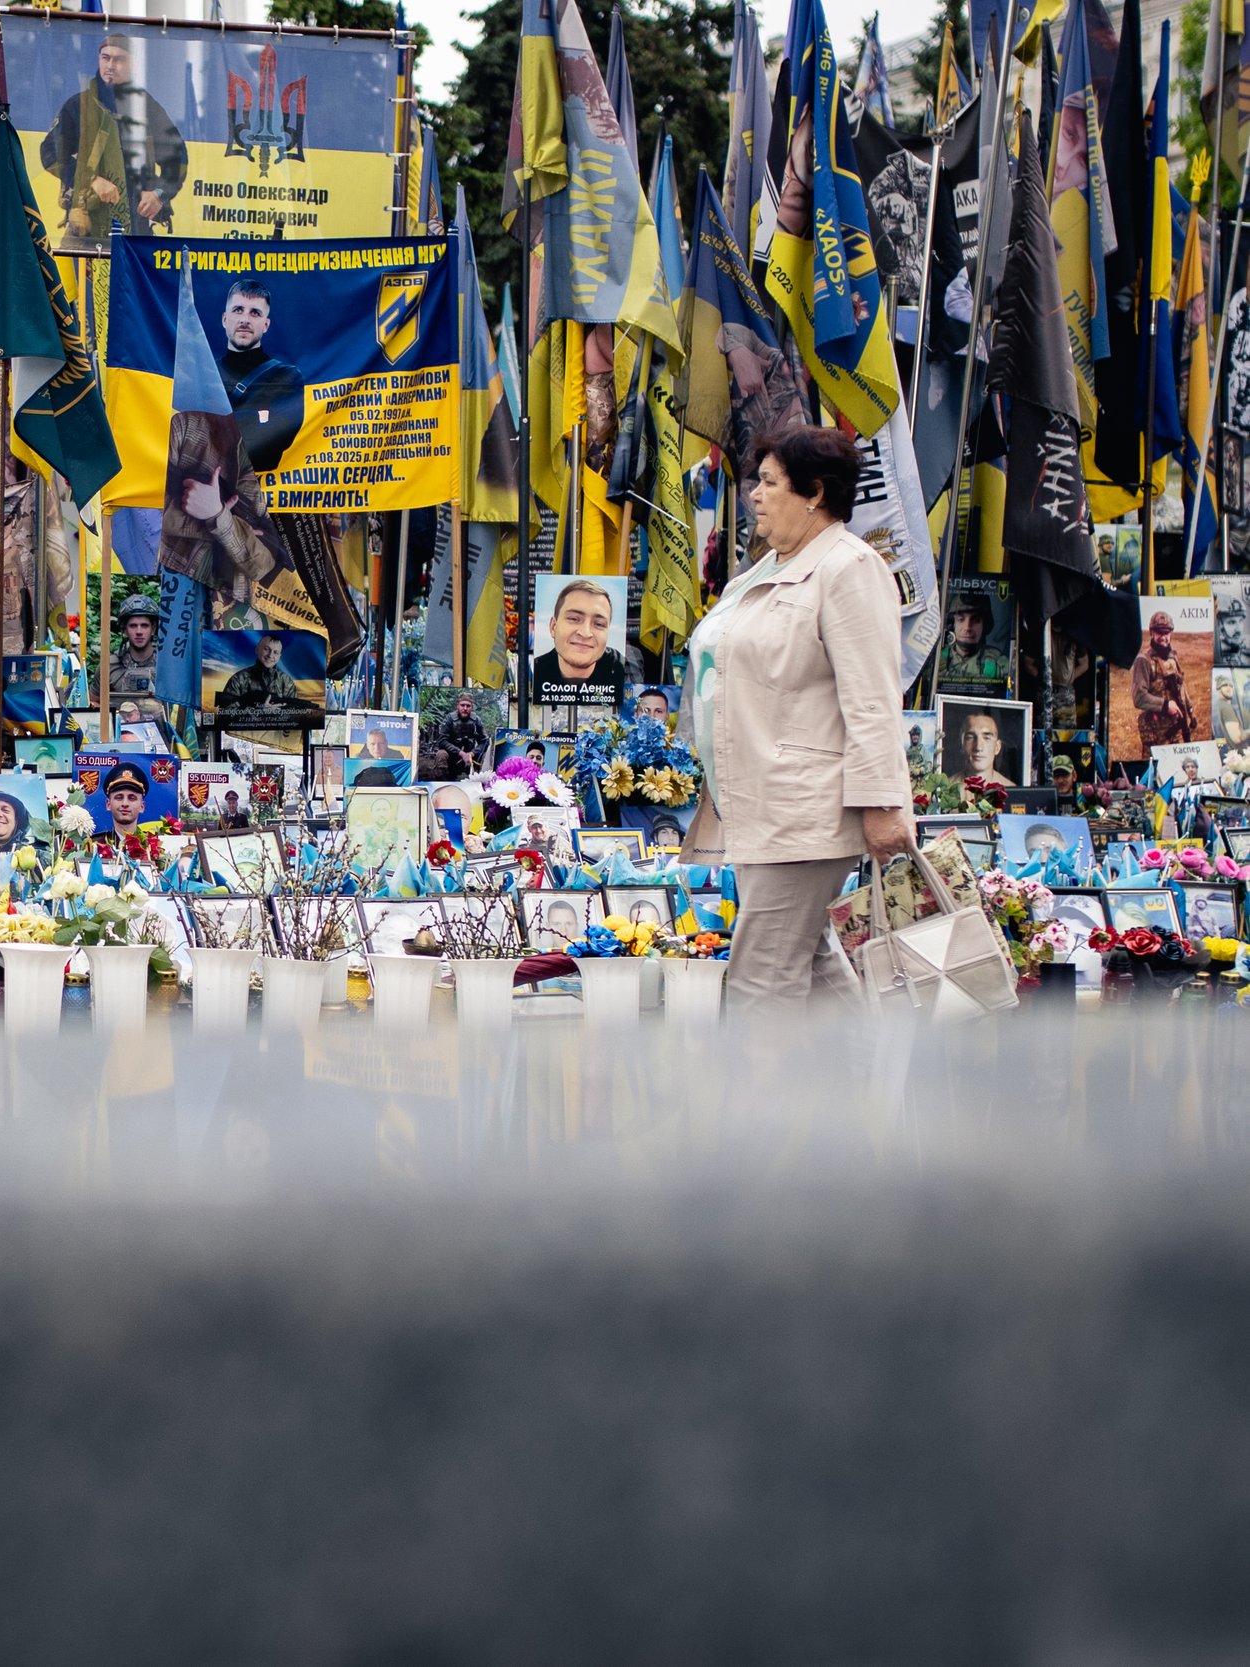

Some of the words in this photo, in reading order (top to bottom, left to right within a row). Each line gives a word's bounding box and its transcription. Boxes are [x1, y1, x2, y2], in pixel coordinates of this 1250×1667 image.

[193, 179, 233, 198] Янко
[237, 181, 329, 206] Олександр
[202, 204, 318, 228] Миколайович
[153, 250, 171, 270] 12
[254, 246, 415, 274] СПЕЦПРИЗНАЧЕННЯ
[417, 243, 447, 264] НГУ
[384, 277, 423, 288] АЗОВ
[313, 384, 353, 402] ПАНОВ
[325, 391, 382, 415] ПОЗИВНИЙ
[385, 386, 447, 406] «АККЕРМАН»
[350, 409, 400, 421] 05.02.1997
[322, 423, 369, 438] ЗАГИНУВ
[371, 421, 389, 435] ПРИ
[390, 417, 439, 434] ВИКОНАННІ
[331, 435, 382, 449] БОЙОВОГО
[383, 432, 432, 447] ЗАВДАННЯ
[305, 451, 362, 465] 21.08.2025
[372, 450, 378, 462] В
[379, 443, 432, 462] ДОНЕЦЬКІЙ
[265, 472, 277, 487] В
[280, 466, 340, 486] НАШИХ
[343, 464, 405, 485] СЕРЦЯХ...
[277, 489, 369, 509] ВМИРАЮТЬ!
[1179, 608, 1210, 619] АКІМ
[542, 682, 577, 693] Солоп
[579, 682, 616, 694] Денис
[1173, 745, 1201, 756] Каспер
[77, 756, 88, 765] 95
[90, 757, 117, 767] ОДШБр
[189, 774, 199, 783] 95
[200, 774, 229, 784] ОДШБр
